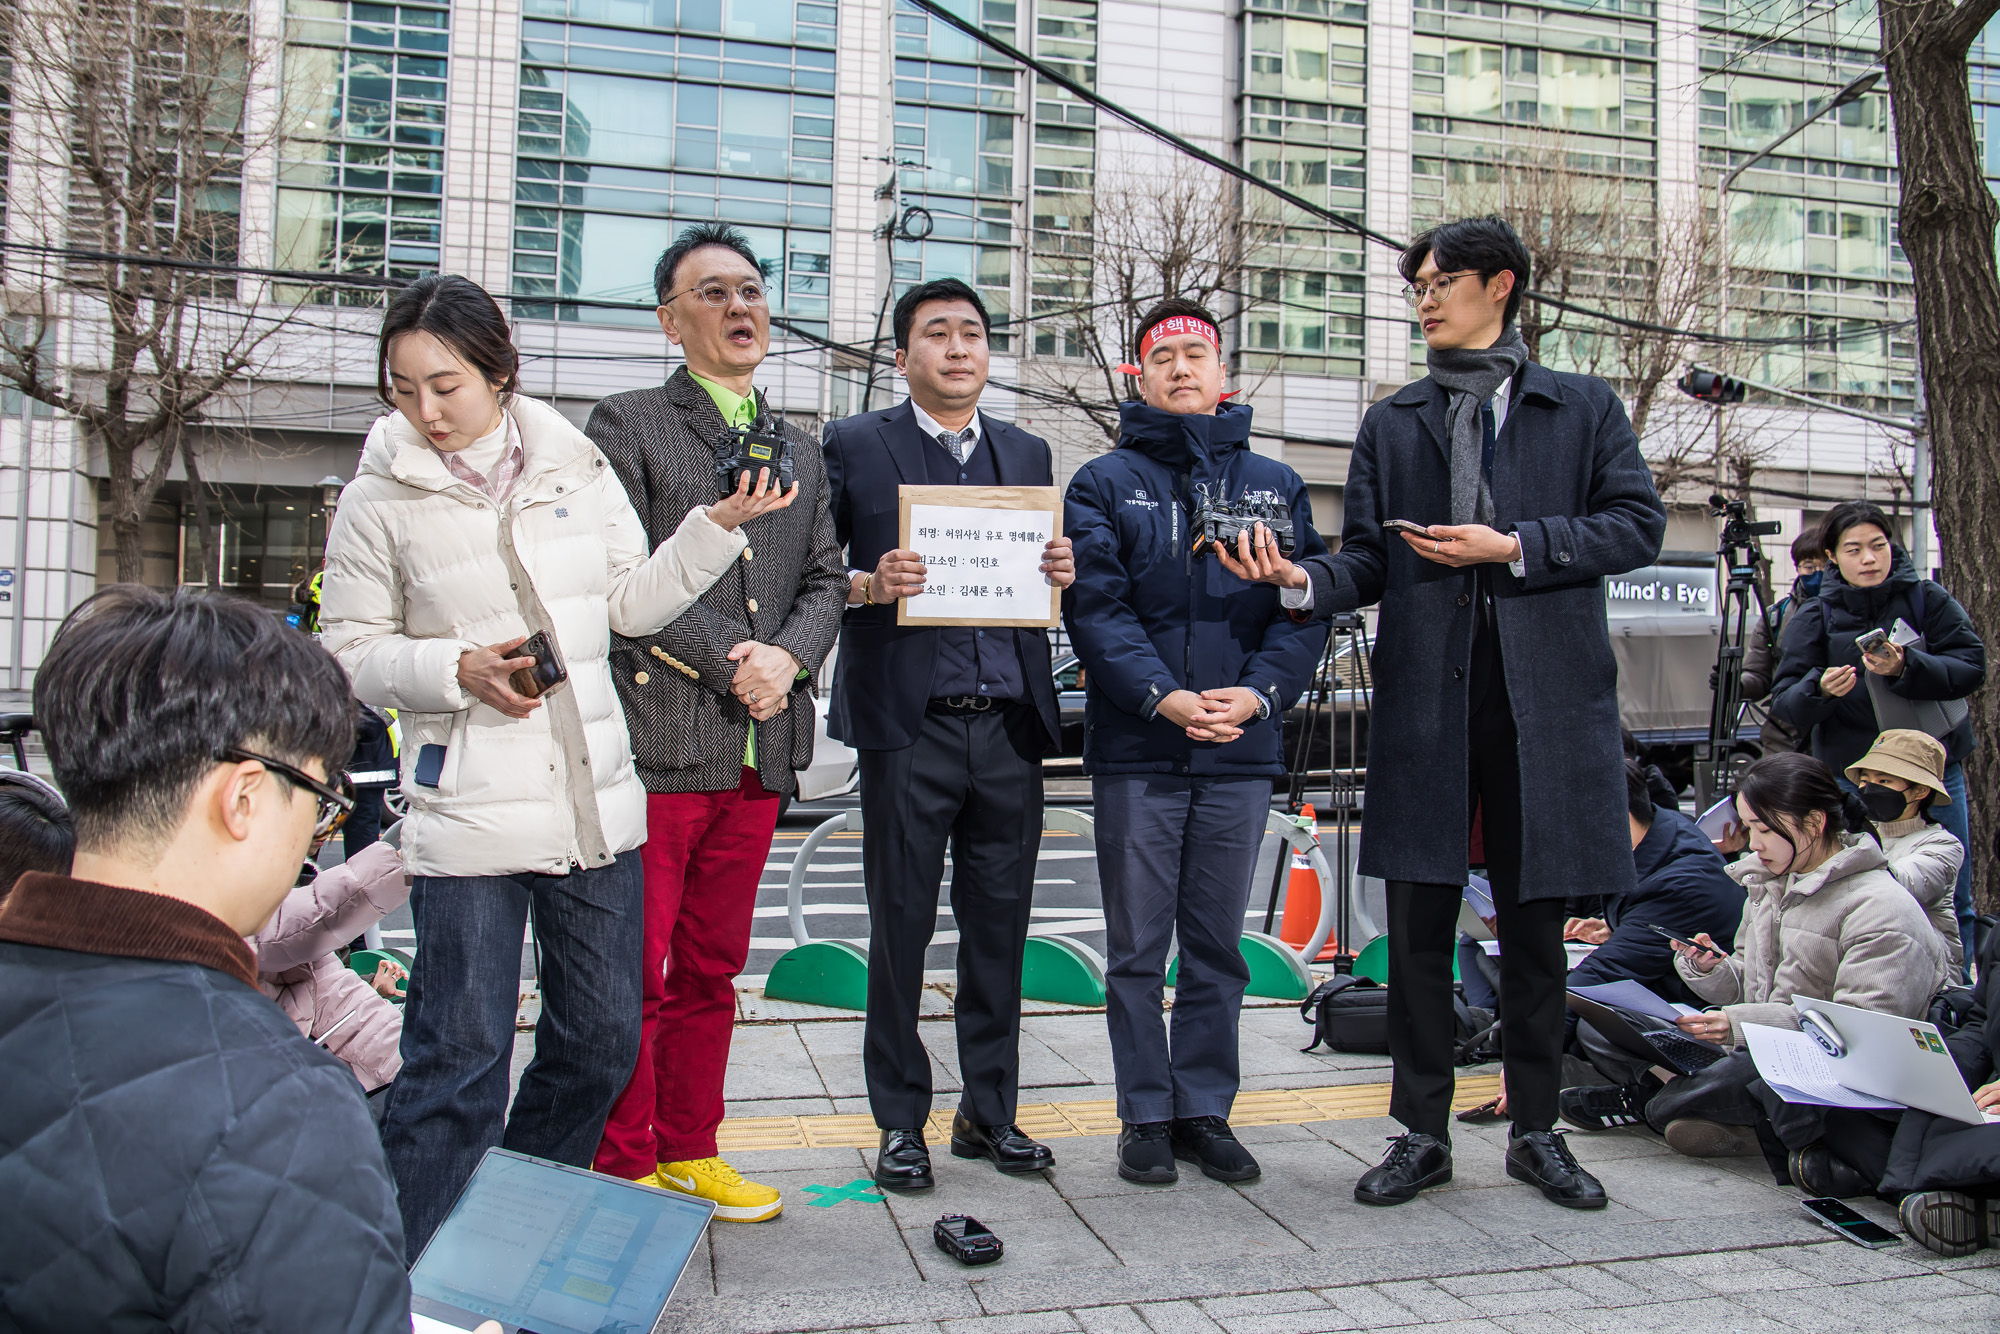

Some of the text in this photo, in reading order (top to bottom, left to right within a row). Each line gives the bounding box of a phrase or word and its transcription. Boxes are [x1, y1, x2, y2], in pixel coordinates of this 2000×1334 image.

[1151, 318, 1215, 345] 탄핵반대
[918, 527, 1045, 543] 죄명: 허위사실 유포 명예훼손
[970, 556, 1000, 569] 이진호
[959, 585, 989, 598] 김새론
[994, 586, 1014, 598] 유족
[1608, 581, 1710, 604] Mind's Eye
